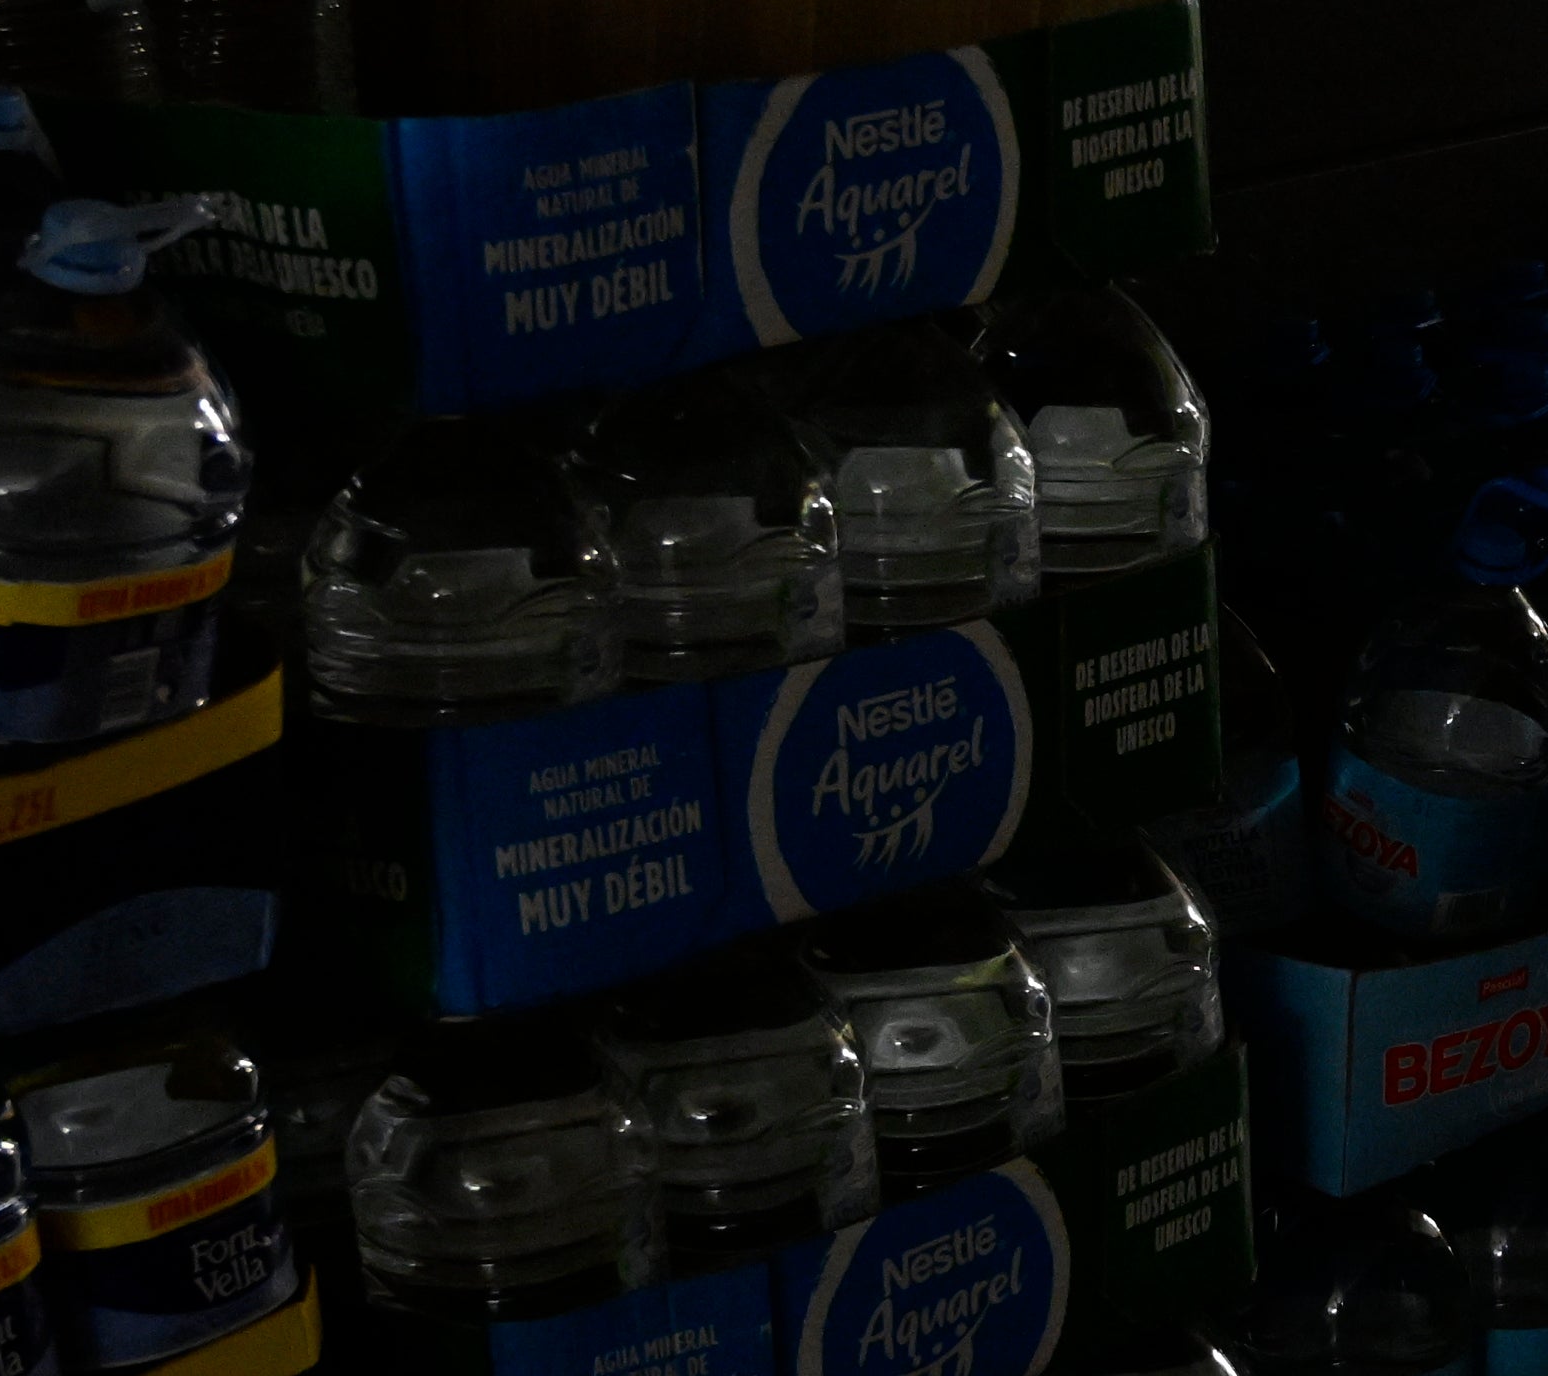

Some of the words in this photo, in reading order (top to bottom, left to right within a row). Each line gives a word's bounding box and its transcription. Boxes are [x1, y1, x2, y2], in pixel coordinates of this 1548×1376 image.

[824, 98, 947, 163] Nestlé
[1062, 95, 1084, 132] DE
[1086, 77, 1155, 124] RESERVA
[1158, 72, 1178, 109] DE
[522, 161, 573, 193] AGUA
[576, 144, 651, 184] MINERAL
[1070, 120, 1150, 170] BIOSFERA
[1151, 115, 1171, 149] DE
[1173, 107, 1193, 144] LA
[536, 182, 615, 220] NATURAL
[794, 142, 973, 237] Aquarel
[1102, 156, 1166, 202] UNESCO
[483, 198, 687, 276] MINERALIZACIÓN
[503, 279, 582, 338] MUY
[590, 256, 674, 321] DÉBIL
[1074, 657, 1097, 692] DE
[1098, 636, 1169, 685] RESERVA
[1170, 630, 1191, 662] DE
[836, 675, 958, 749] Nestlé
[1082, 677, 1161, 729] BIOSFERA
[1162, 668, 1185, 703] DE
[1185, 661, 1206, 697] LA
[1114, 709, 1177, 757] UNESCO
[528, 762, 580, 797] AGUA
[582, 744, 663, 781] MINERAL
[810, 714, 985, 825] Aquarel
[542, 783, 627, 822] NATURAL
[494, 795, 703, 880] MINERALIZACIÓN
[518, 876, 592, 937] MUY
[603, 852, 694, 916] DÉBIL
[1115, 1163, 1137, 1200] DE
[1139, 1135, 1206, 1188] RESERVA
[1207, 1125, 1227, 1159] DE
[1124, 1174, 1197, 1232] BIOSFERA
[1199, 1163, 1220, 1197] DE
[1221, 1155, 1240, 1191] LA
[189, 1222, 260, 1274] Font
[881, 1213, 997, 1300] Nestlé
[1152, 1203, 1213, 1254] UNESCO
[193, 1253, 268, 1303] Vella
[856, 1244, 1023, 1368] Aquarel
[642, 1324, 720, 1360] MINERAL
